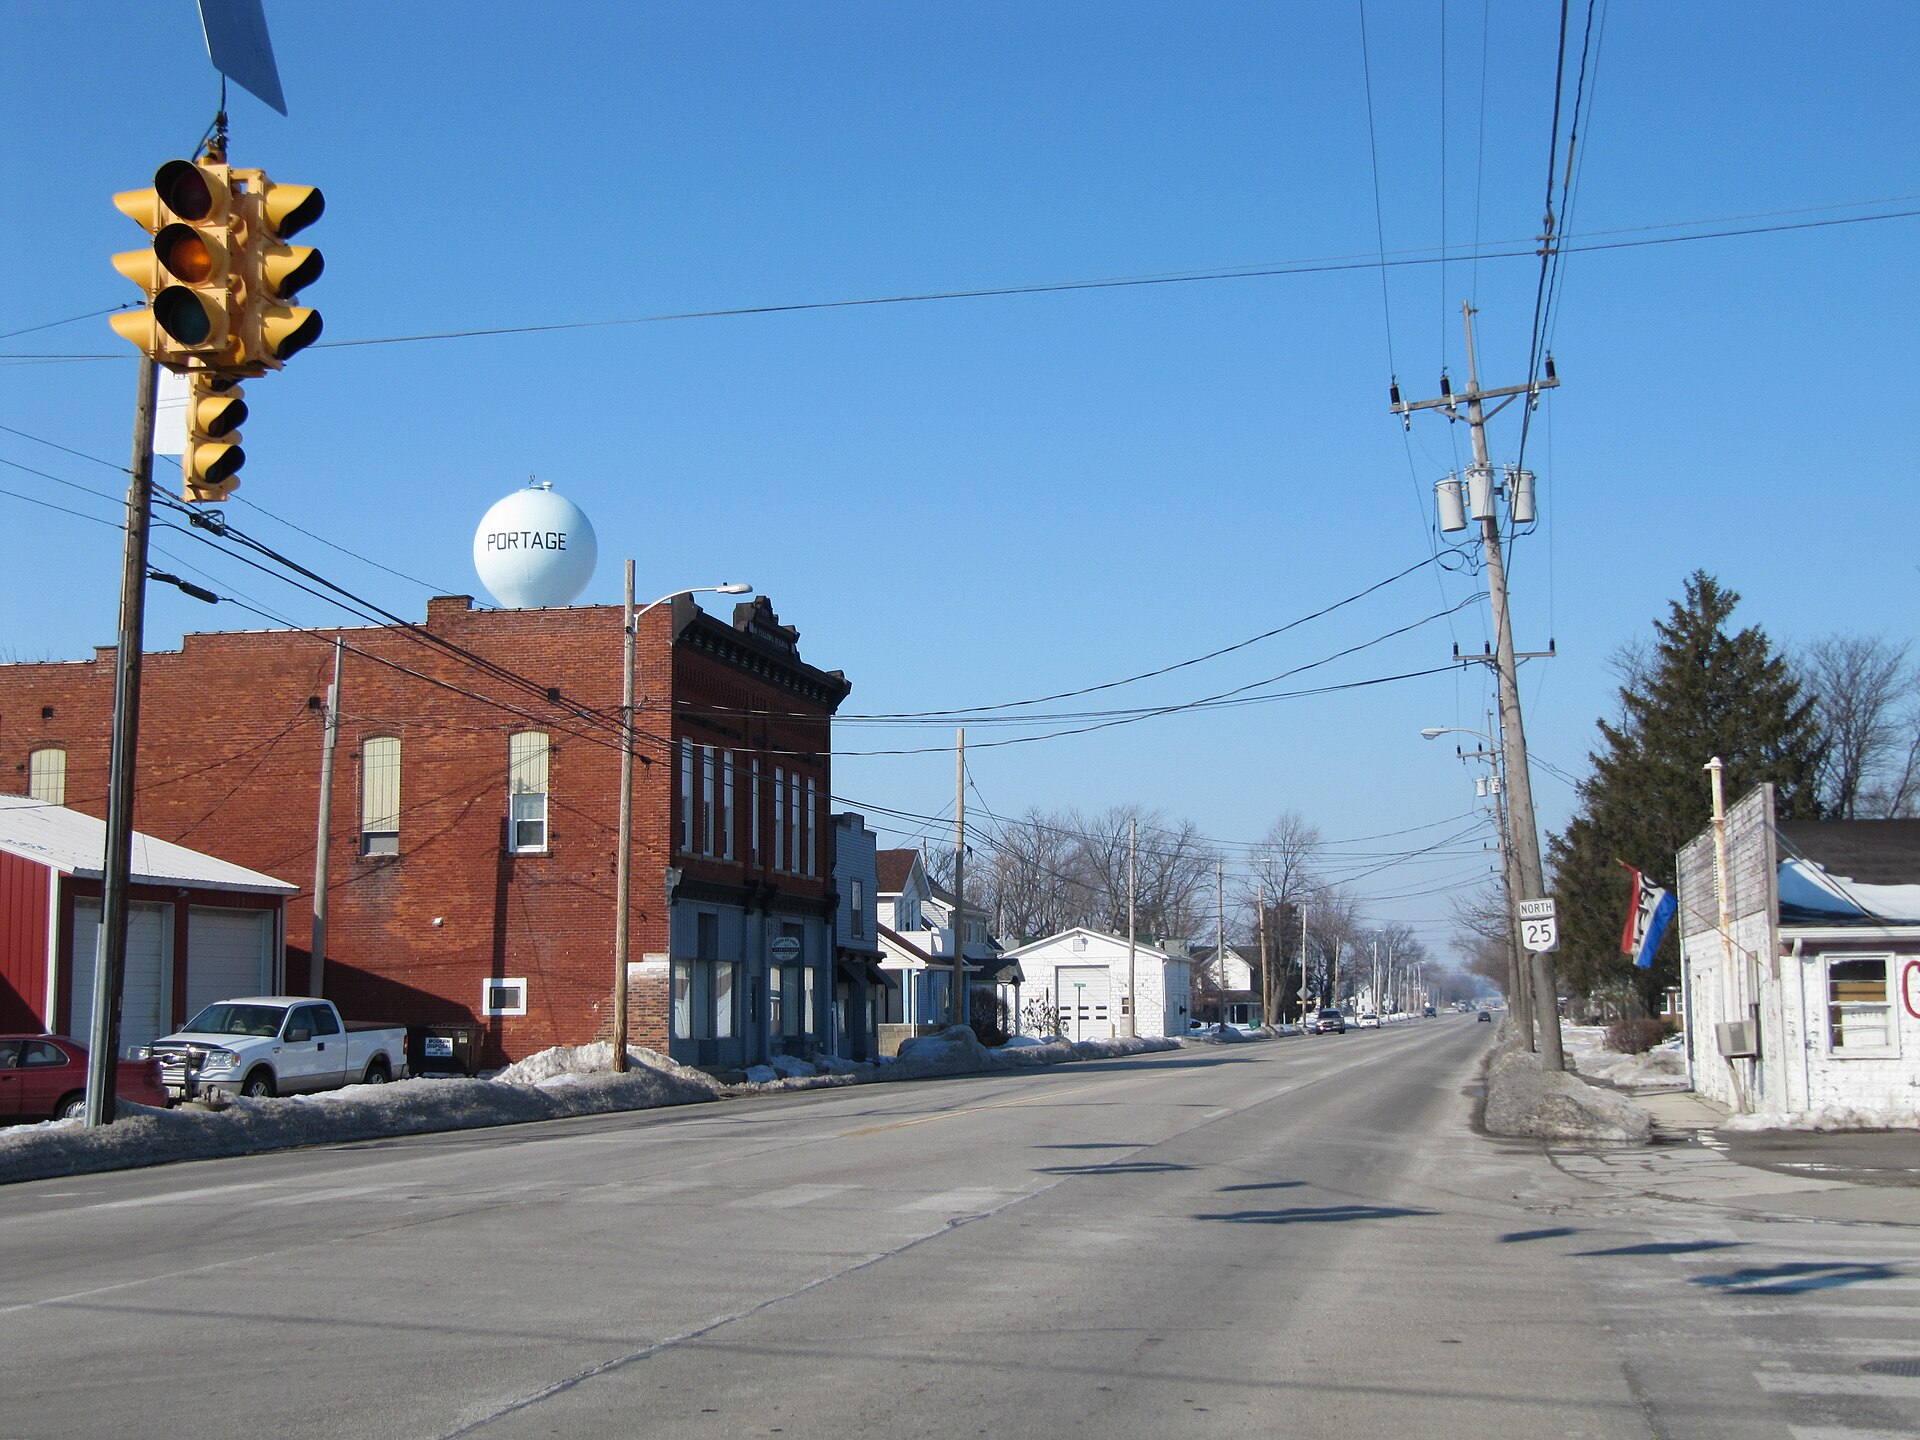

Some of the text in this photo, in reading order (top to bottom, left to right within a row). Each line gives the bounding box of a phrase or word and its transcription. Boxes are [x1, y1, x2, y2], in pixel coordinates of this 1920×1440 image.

[487, 531, 567, 551] PORTAGE
[1520, 902, 1552, 914] NORTH
[1527, 924, 1551, 943] 25
